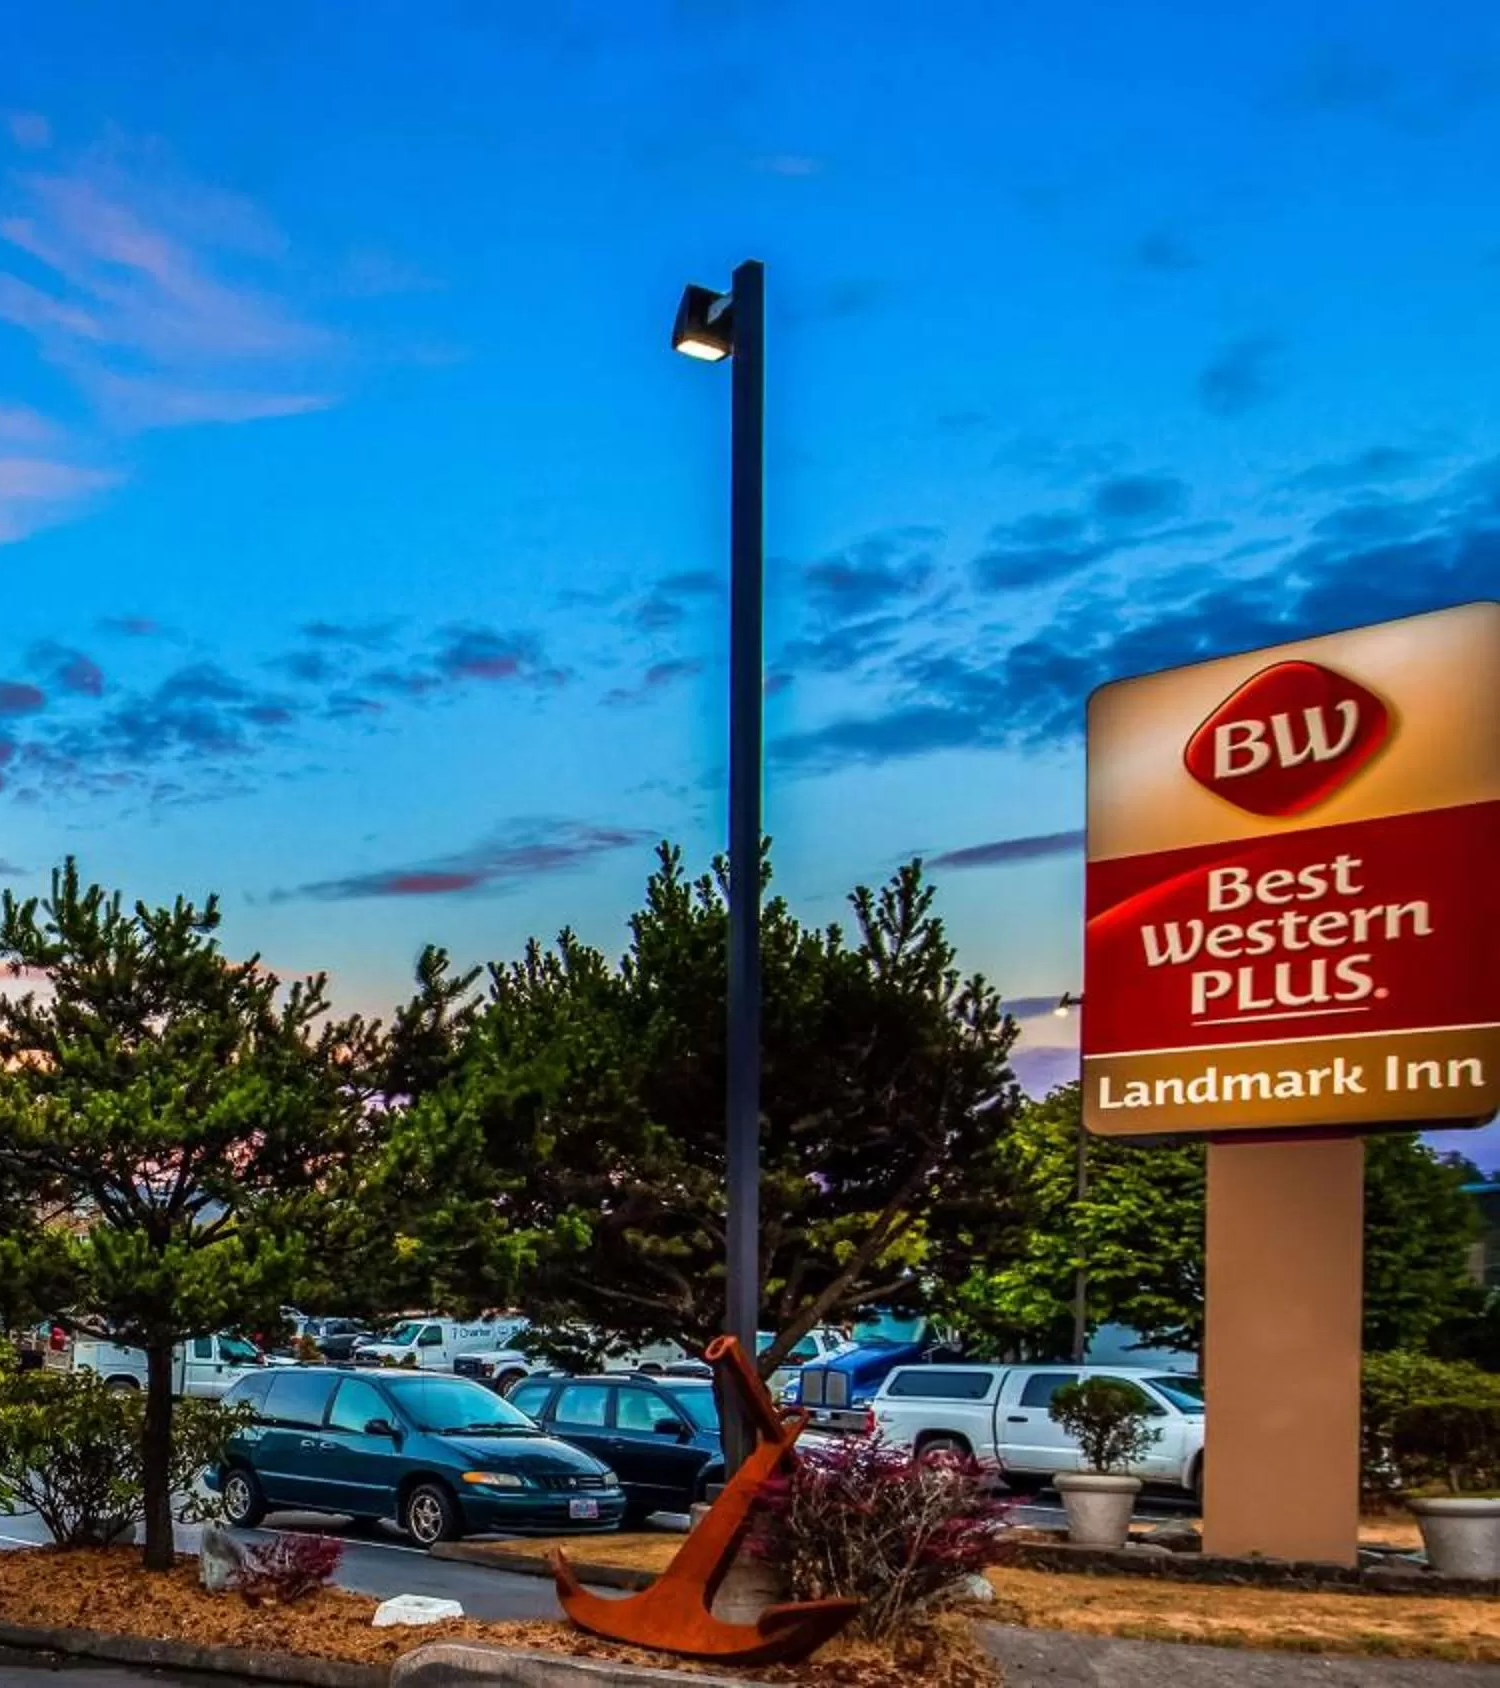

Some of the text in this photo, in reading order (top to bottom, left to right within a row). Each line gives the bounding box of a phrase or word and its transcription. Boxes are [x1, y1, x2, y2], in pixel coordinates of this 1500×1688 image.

[1214, 700, 1359, 779] BW
[1207, 853, 1363, 912] Best
[1141, 900, 1433, 967] Western
[1099, 1055, 1485, 1110] Landmark Inn
